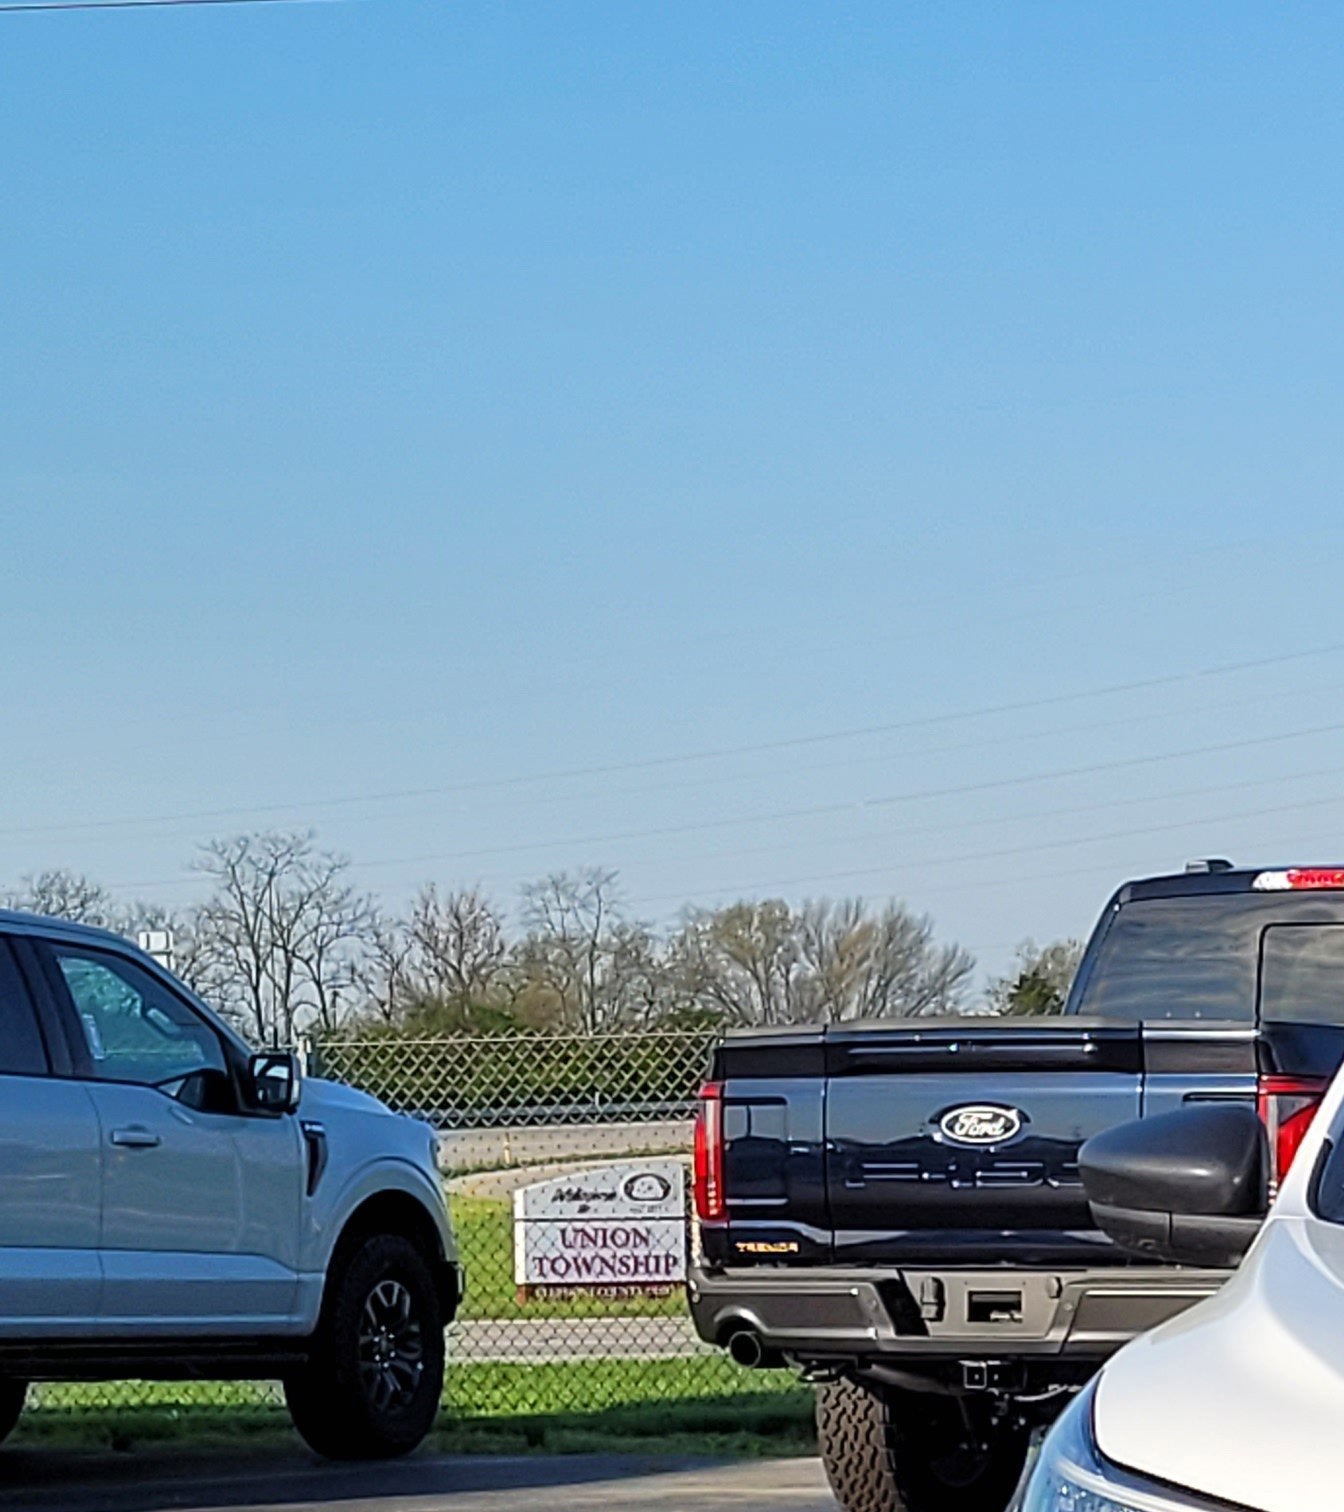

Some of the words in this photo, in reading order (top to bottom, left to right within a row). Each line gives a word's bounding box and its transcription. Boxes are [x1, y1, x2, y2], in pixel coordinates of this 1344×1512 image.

[954, 1112, 1006, 1137] Ford
[559, 1227, 651, 1249] UNION
[532, 1254, 679, 1278] TOWNSHIP
